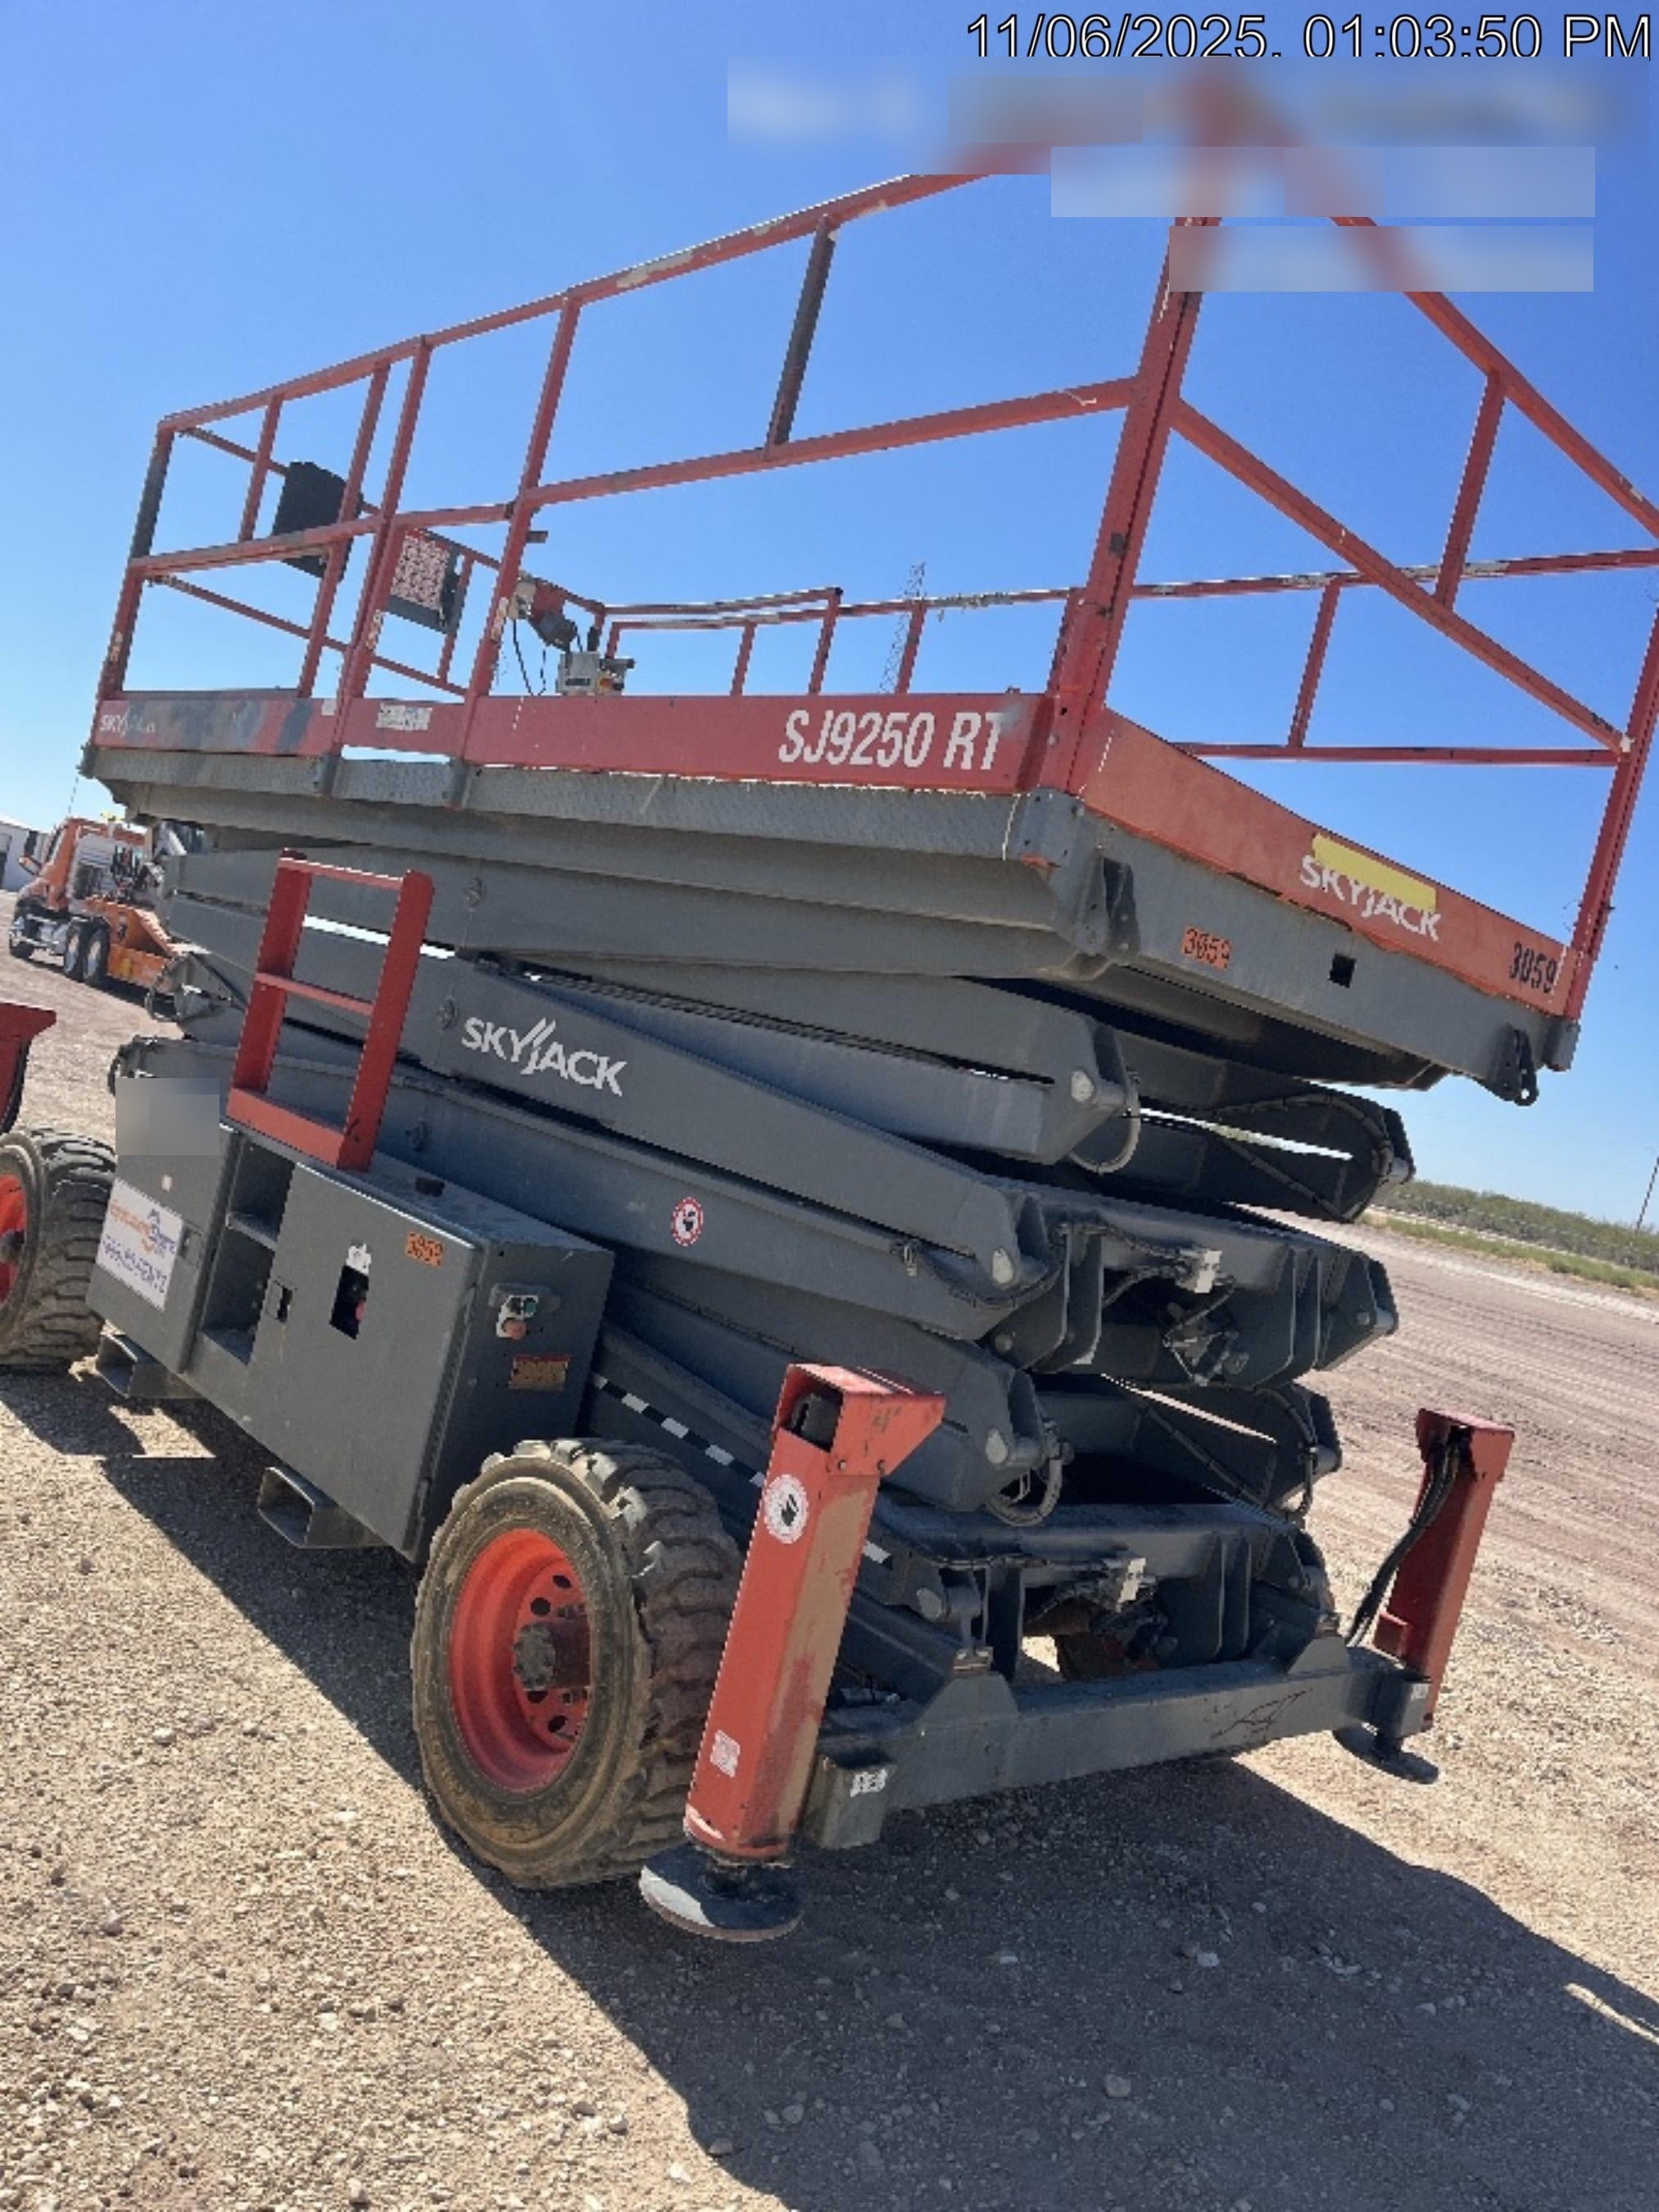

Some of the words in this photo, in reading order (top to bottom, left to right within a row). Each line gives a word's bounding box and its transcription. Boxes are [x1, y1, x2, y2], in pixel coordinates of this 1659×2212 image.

[778, 709, 936, 768] SJ9250
[943, 712, 1004, 770] RT
[1299, 855, 1441, 941] SKYJACK
[1509, 941, 1557, 994] 3059
[461, 1017, 628, 1097] SKYJACK
